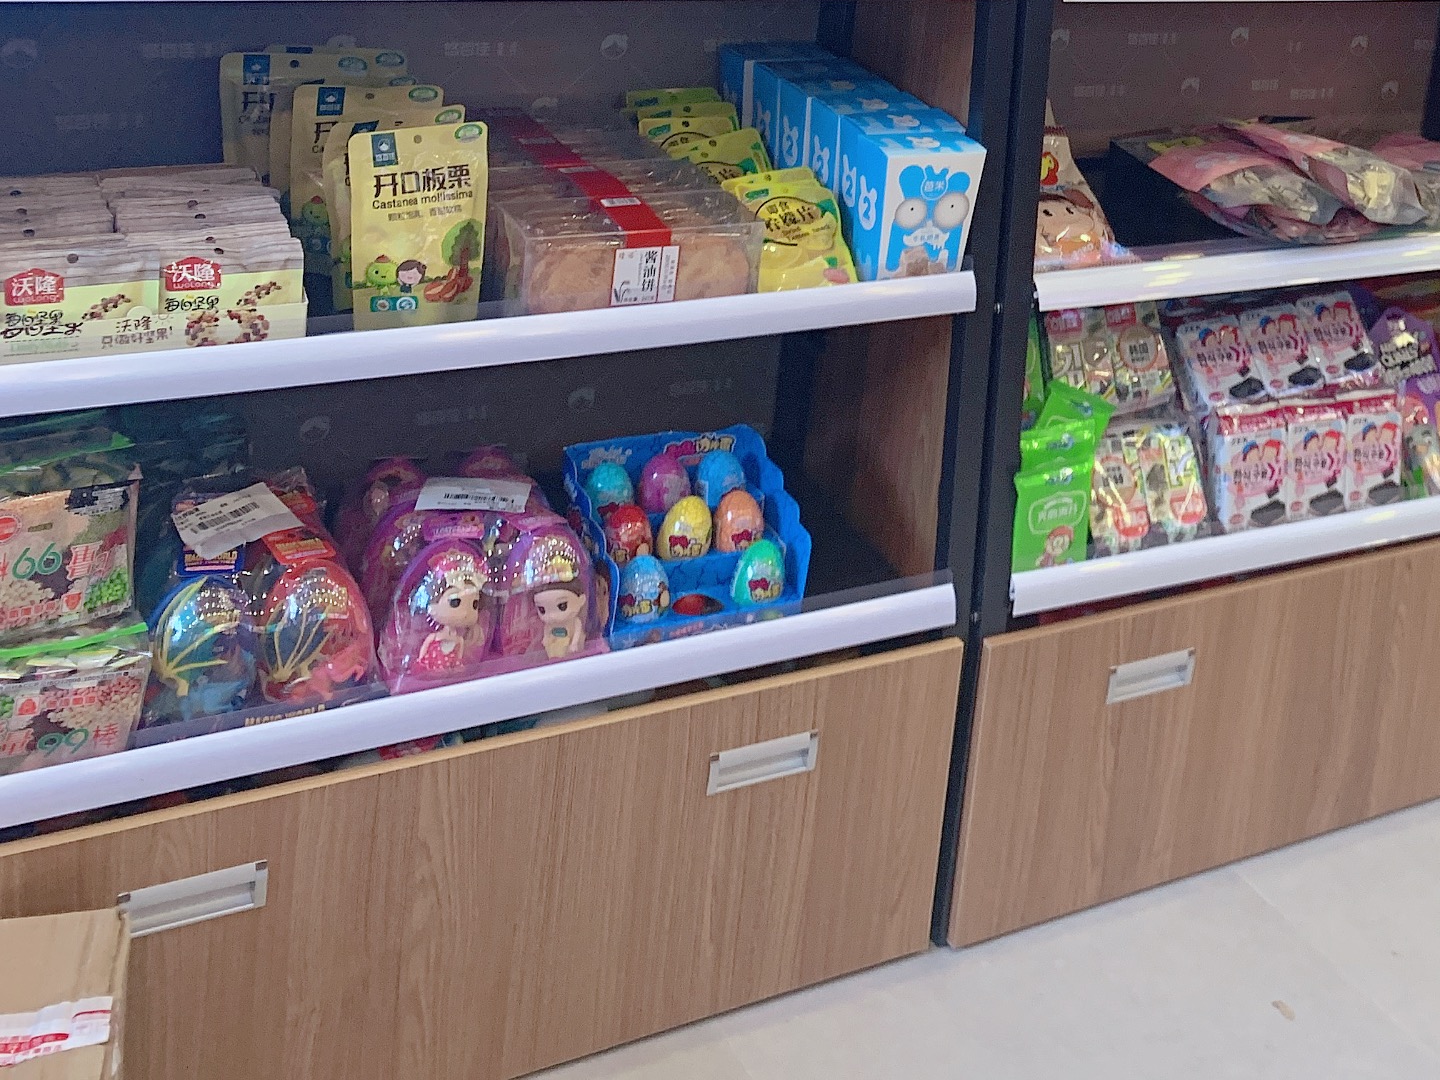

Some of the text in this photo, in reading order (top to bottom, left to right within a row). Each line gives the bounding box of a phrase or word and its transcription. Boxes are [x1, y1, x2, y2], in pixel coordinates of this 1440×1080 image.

[373, 164, 471, 199] 开口板栗
[372, 189, 474, 210] Castanea mollissima
[170, 263, 215, 281] 沃隆
[11, 276, 56, 296] 沃隆
[165, 296, 219, 312] 每日坚果
[115, 317, 152, 334] 沃隆
